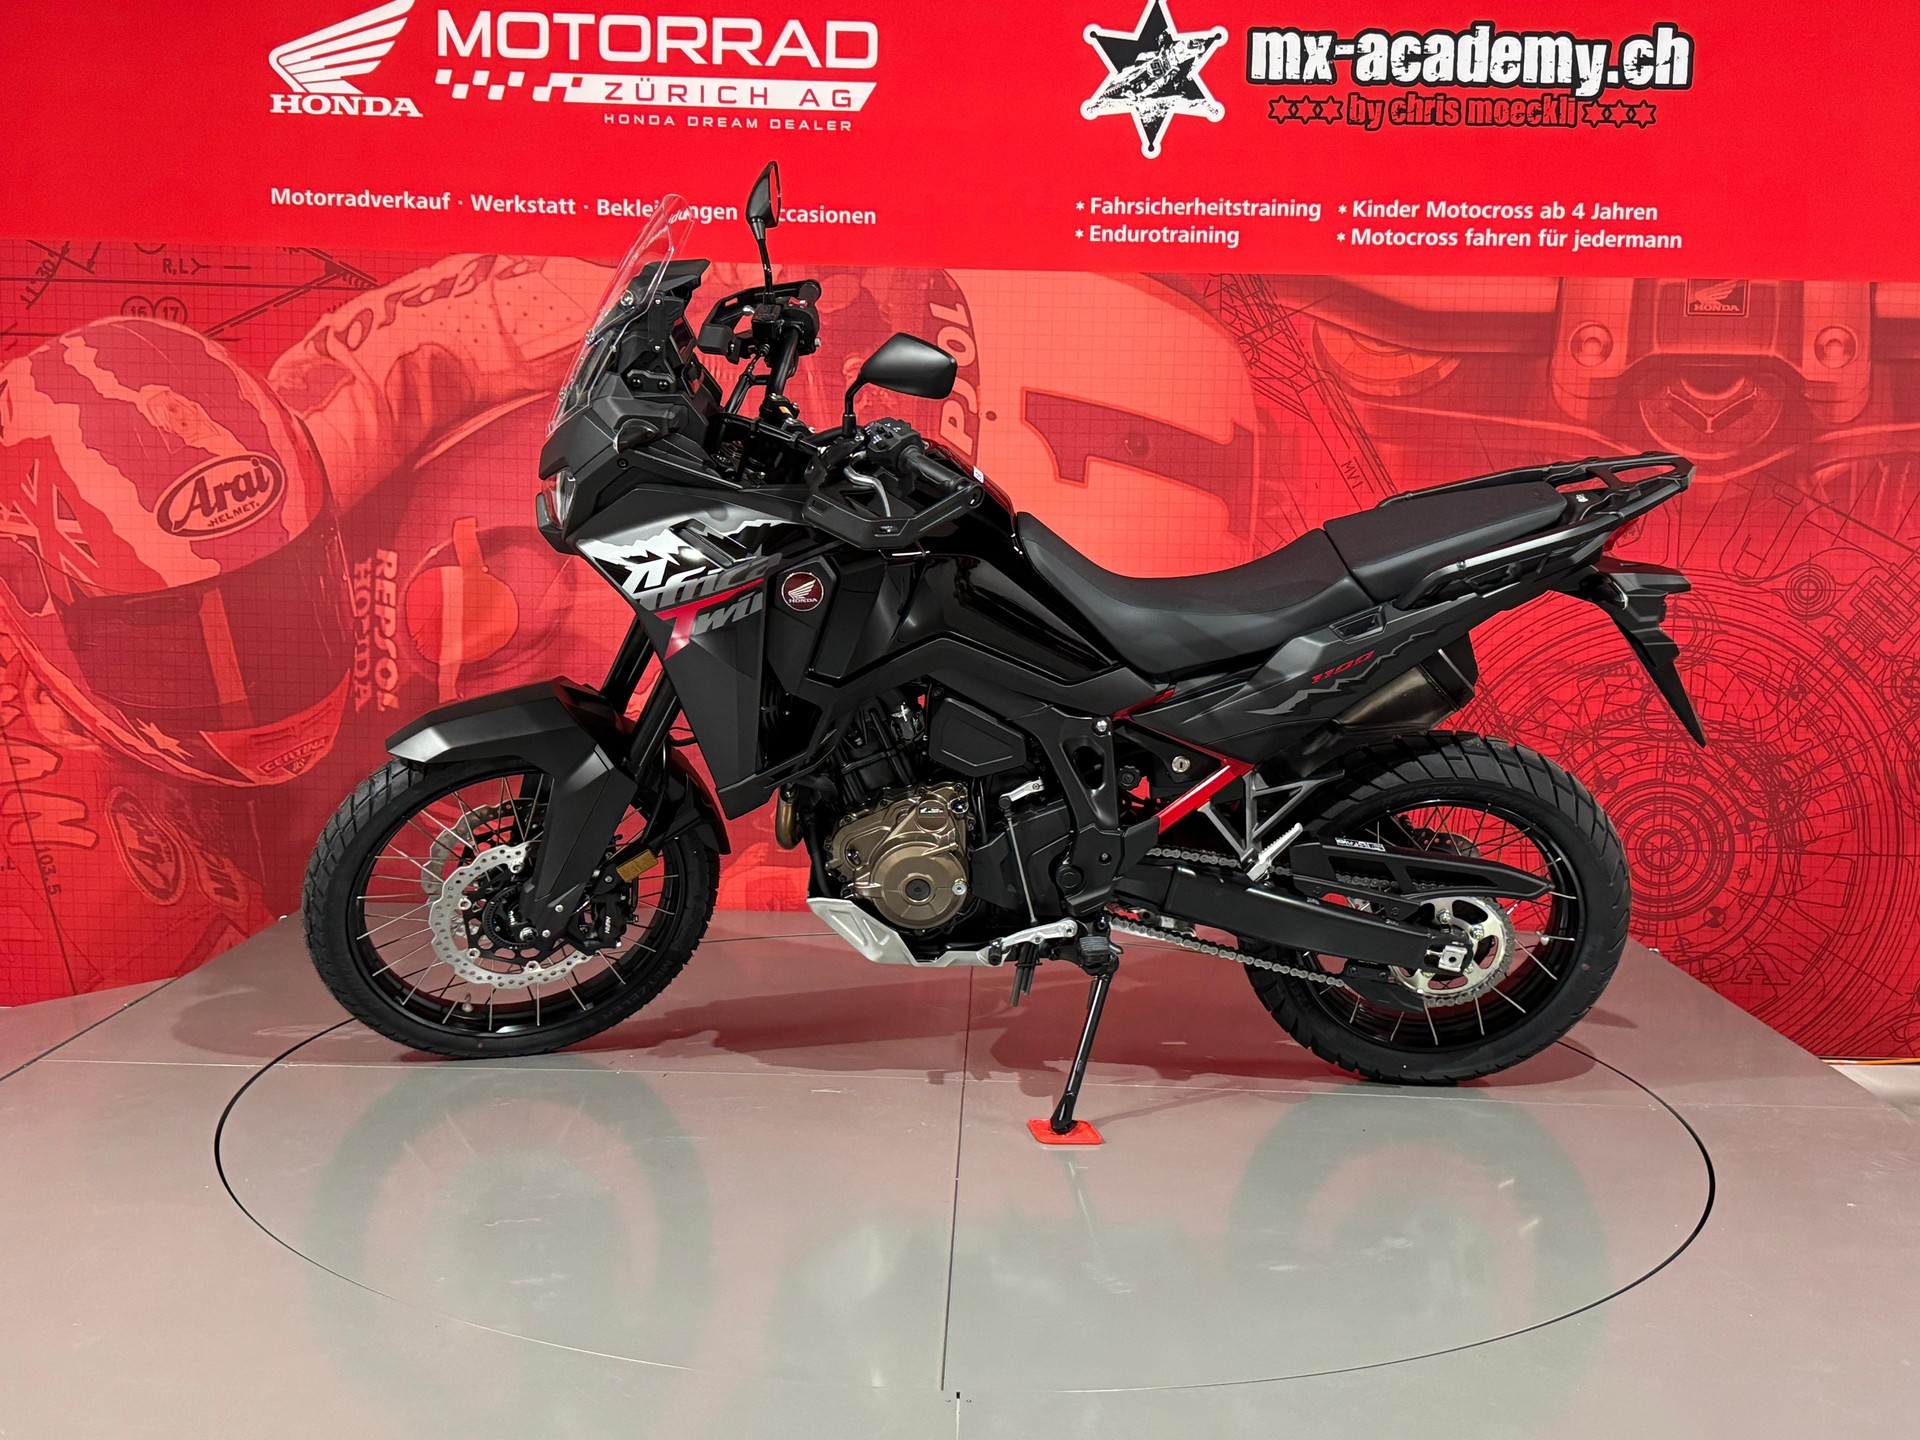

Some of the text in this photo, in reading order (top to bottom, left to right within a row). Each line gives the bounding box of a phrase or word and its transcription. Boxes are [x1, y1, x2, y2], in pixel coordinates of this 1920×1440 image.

[437, 10, 878, 70] MOTORRAD
[1248, 23, 1692, 98] mx-academy.ch
[270, 93, 423, 118] HONDA
[605, 77, 852, 108] ZÜRICH AG
[604, 113, 852, 132] HONDA DREAM DEALER
[1347, 93, 1578, 130] by chris moeckli
[271, 187, 451, 211] Motorradverkauf
[471, 195, 576, 215] Werkstatt
[777, 202, 876, 225] ccasionen
[1091, 197, 1321, 222] Fahrsicherheitstraining
[1353, 200, 1657, 220] Kinder Motocross ab 4 Jahren
[1090, 225, 1240, 248] Endurotraining
[1352, 228, 1682, 251] Motocross fahren für jedermann
[1694, 304, 1740, 312] HONDA
[173, 457, 270, 531] Arai
[373, 549, 400, 712] REPSOL
[1312, 650, 1375, 685] 1100
